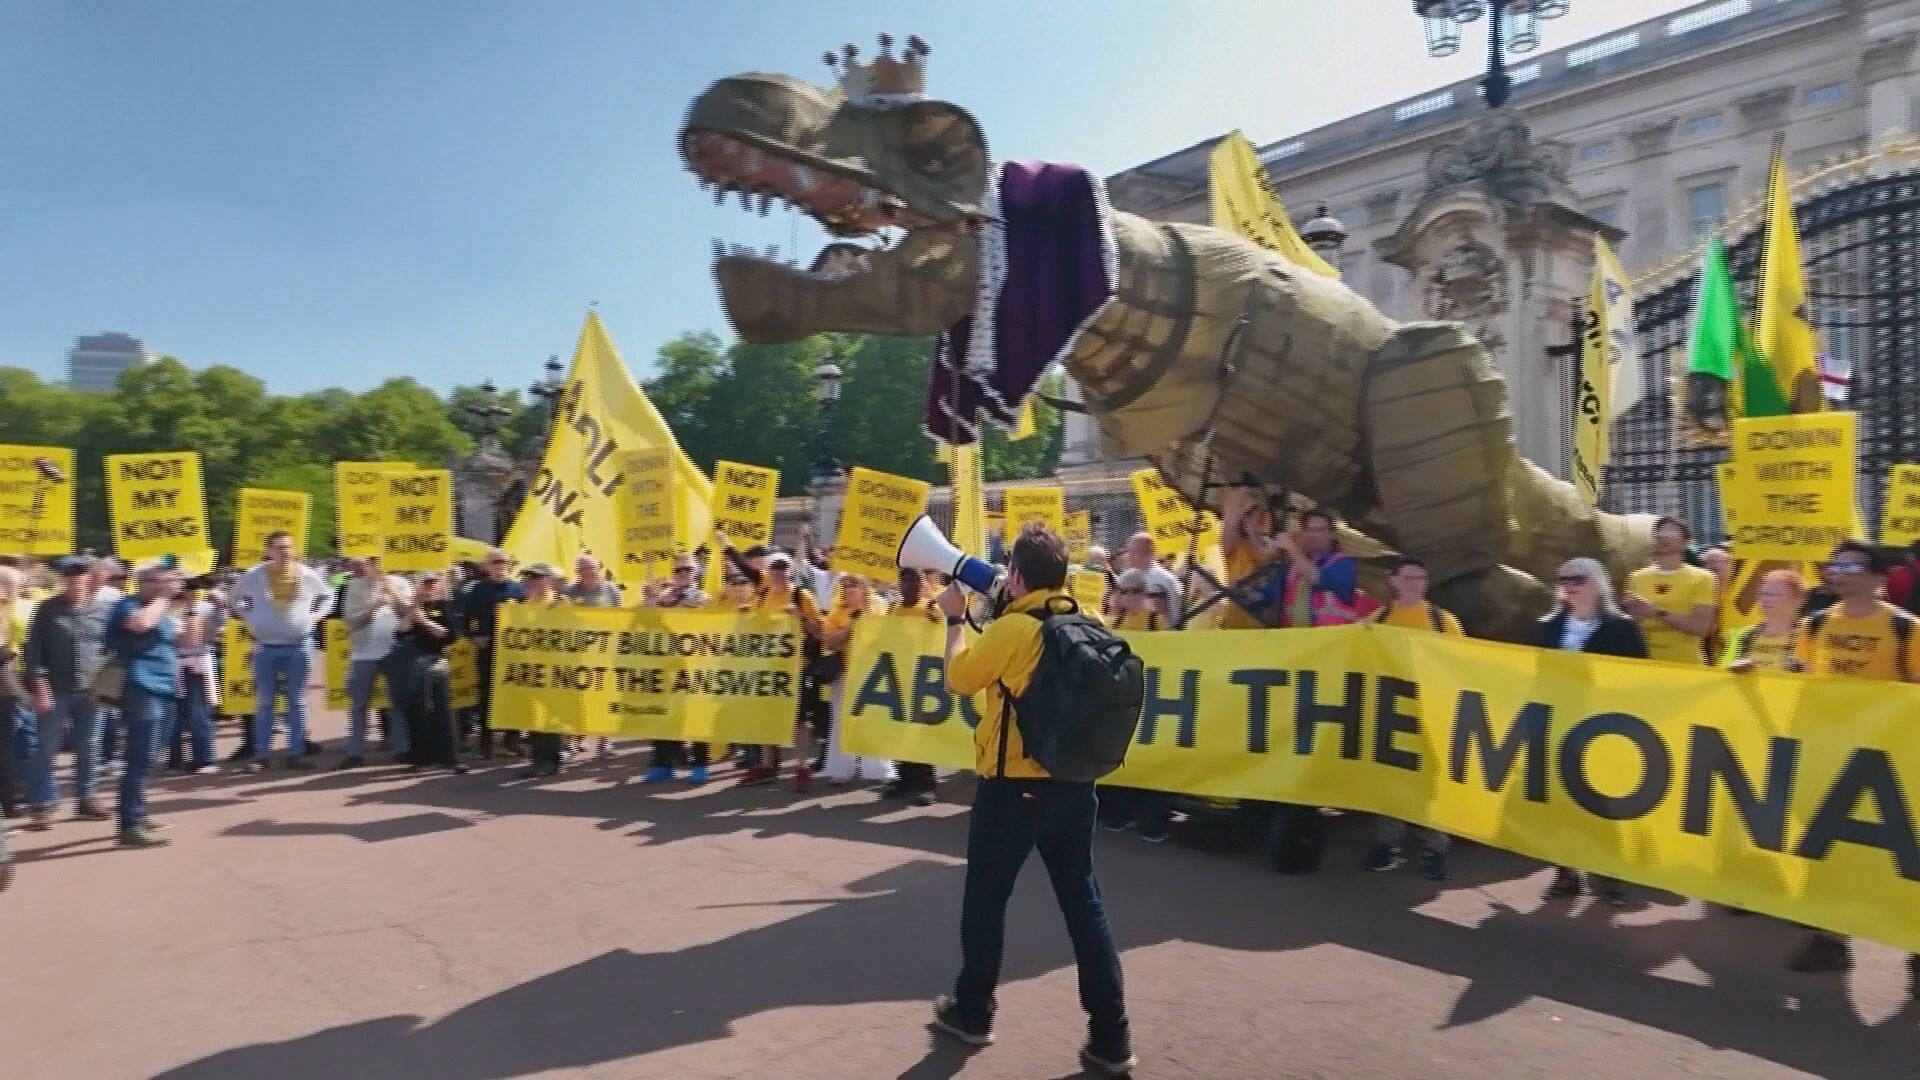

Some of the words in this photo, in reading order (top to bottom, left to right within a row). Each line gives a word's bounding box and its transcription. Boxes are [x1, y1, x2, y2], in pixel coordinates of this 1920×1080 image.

[1747, 427, 1843, 451] DOWN
[120, 459, 185, 481] NOT
[626, 456, 668, 474] DOWN
[1755, 461, 1832, 483] WITH
[345, 472, 383, 486] DO
[388, 477, 442, 497] NOT
[724, 467, 769, 490] NOT
[132, 489, 180, 510] MY
[726, 494, 760, 512] MY
[858, 479, 920, 505] DOWN
[1011, 495, 1059, 507] DOWN
[245, 496, 303, 512] DOWN
[396, 504, 436, 526] MY
[860, 503, 910, 527] WITH
[1763, 493, 1823, 515] THE
[0, 528, 69, 543] ROWN
[120, 517, 199, 541] KING
[623, 523, 674, 543] CROWN
[712, 517, 767, 541] KING
[860, 527, 898, 549] THE
[1736, 524, 1853, 549] CROWN
[384, 532, 449, 554] KING
[836, 545, 899, 571] CROW
[500, 627, 612, 655] CORRUPT
[616, 633, 796, 659] BILLIONAIRES
[1828, 632, 1883, 653] NOT
[501, 663, 547, 689] ARE
[551, 666, 608, 692] NOT
[611, 666, 666, 695] THE
[671, 669, 794, 698] ANSWER
[1228, 668, 1423, 773] THE
[1449, 689, 1920, 883] MONA
